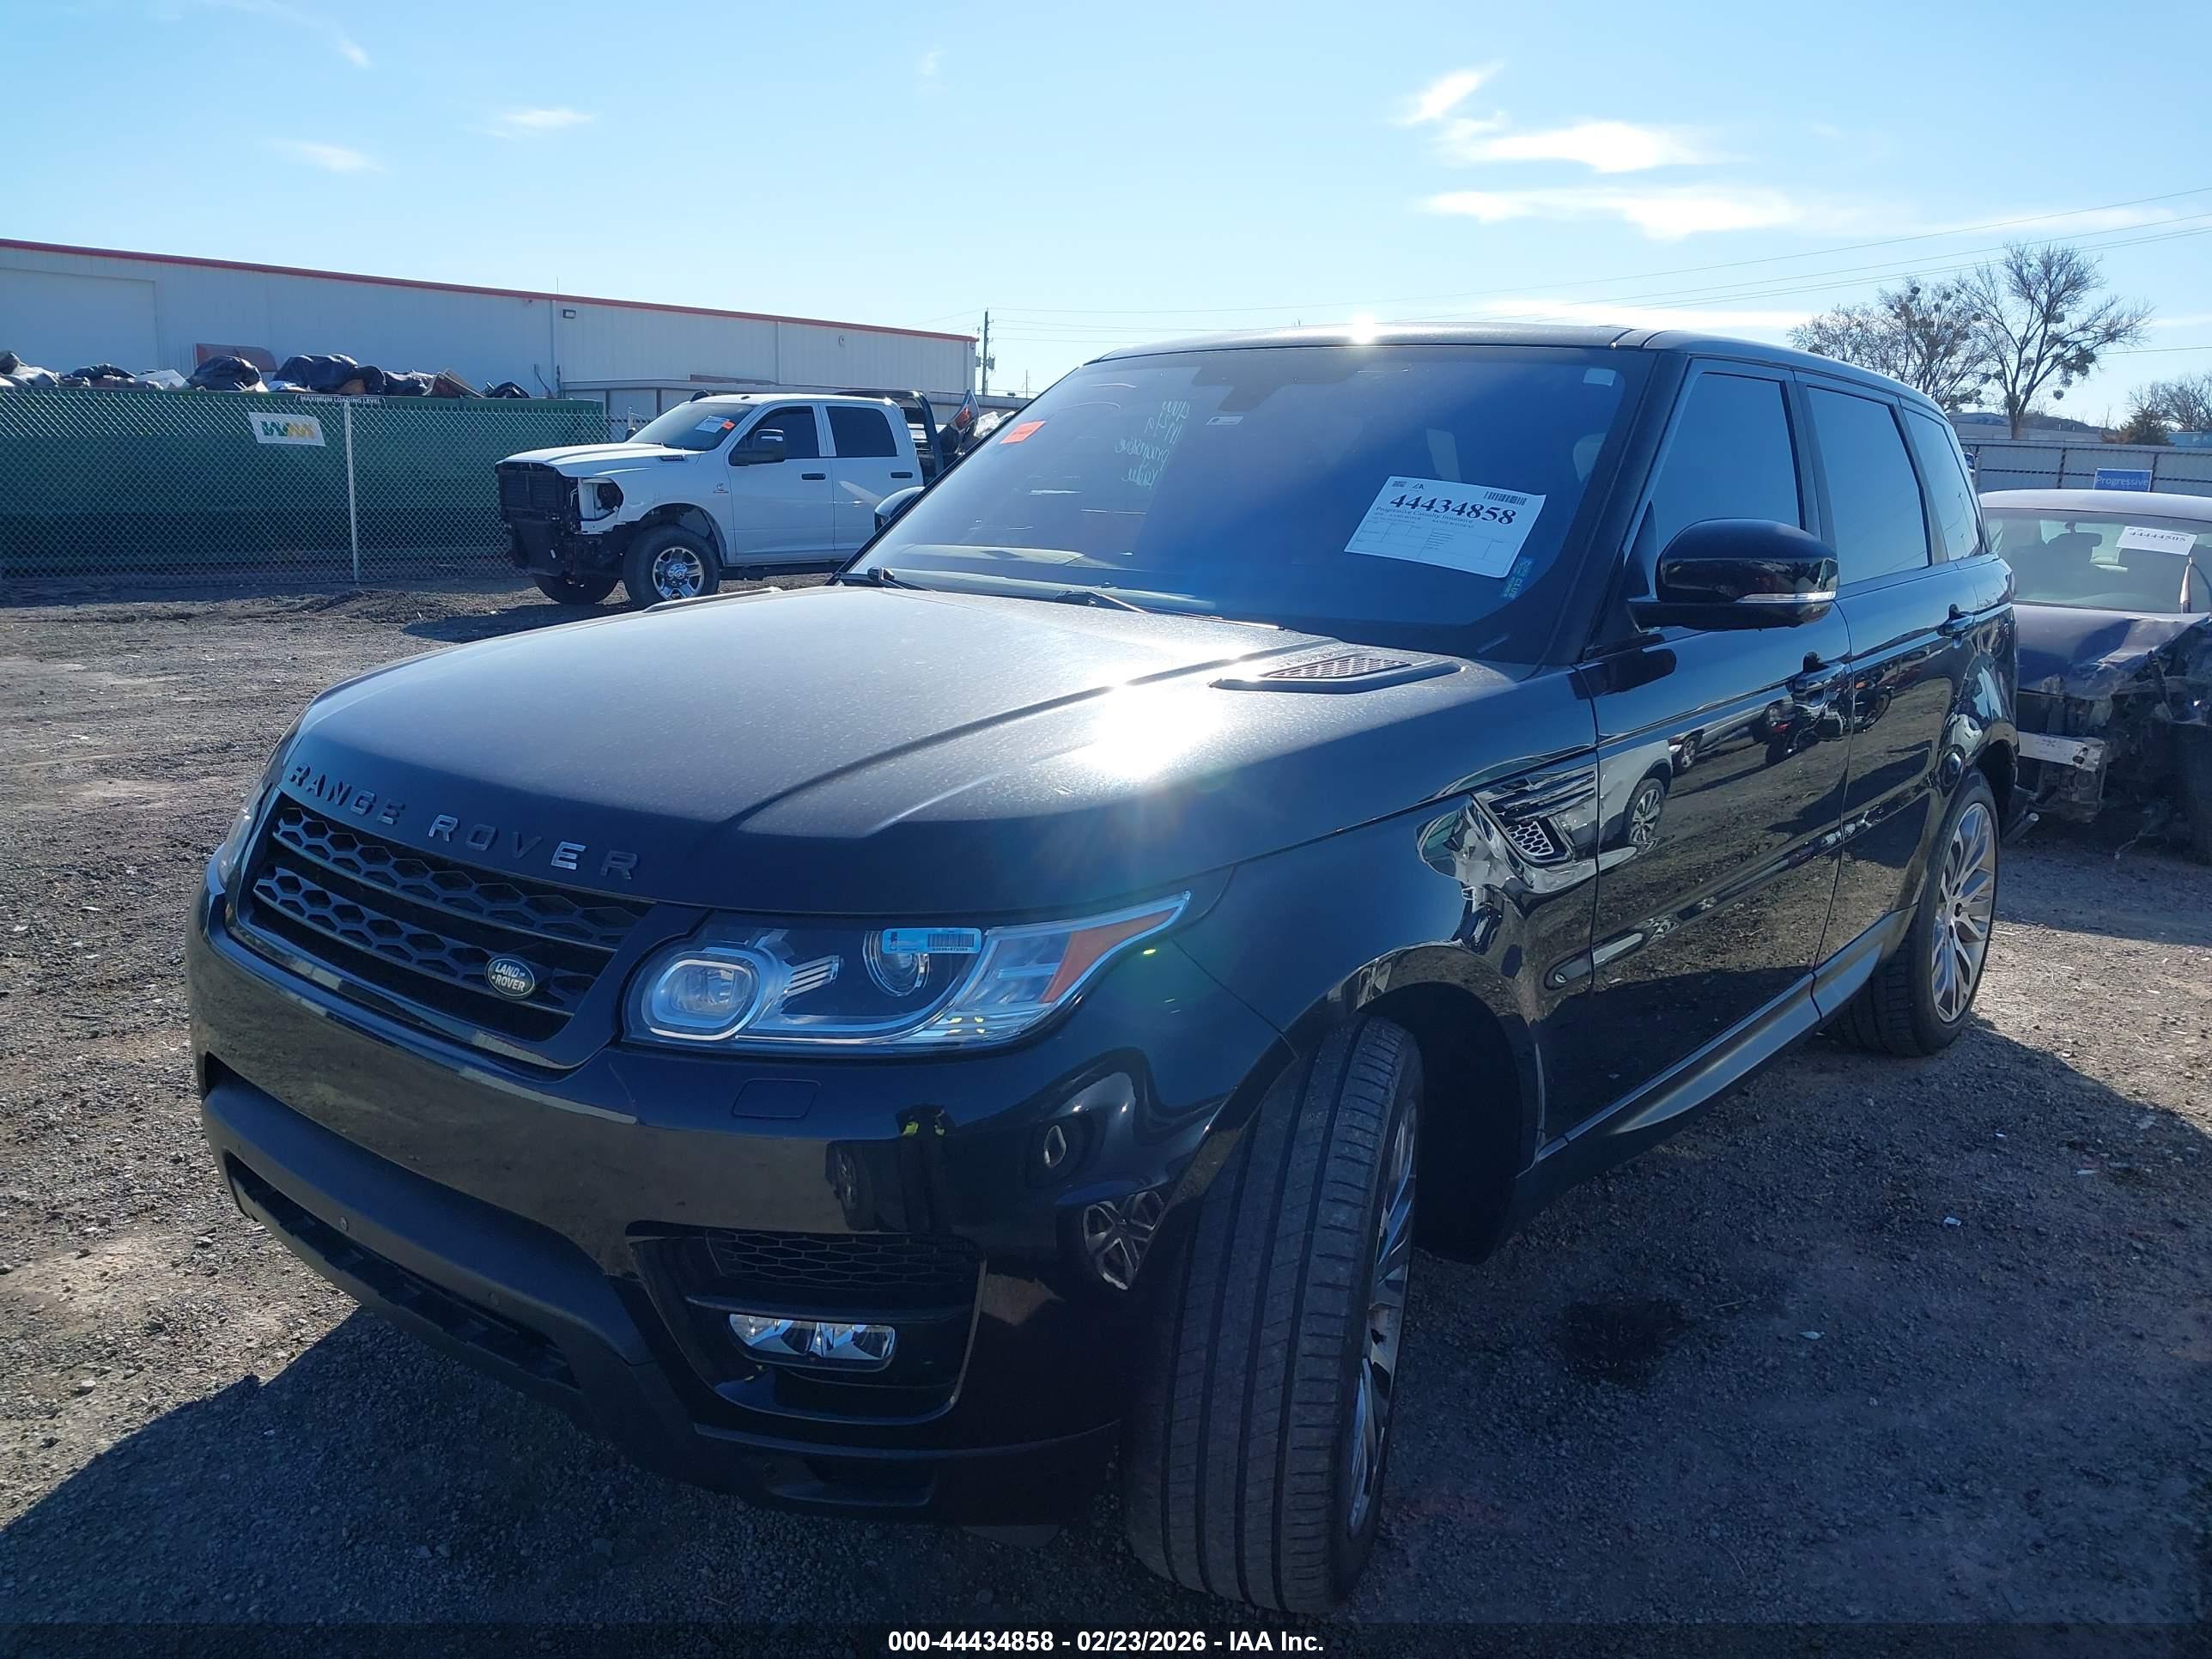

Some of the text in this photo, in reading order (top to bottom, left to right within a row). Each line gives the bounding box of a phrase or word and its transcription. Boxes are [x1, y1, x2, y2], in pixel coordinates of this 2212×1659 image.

[260, 420, 314, 439] WM
[2096, 476, 2149, 486] Progressive
[1376, 506, 1413, 517] Progressive
[1389, 494, 1517, 525] 44434858
[289, 763, 640, 880] RANGE ROVER
[495, 962, 520, 977] LAND
[495, 974, 526, 993] ROVER
